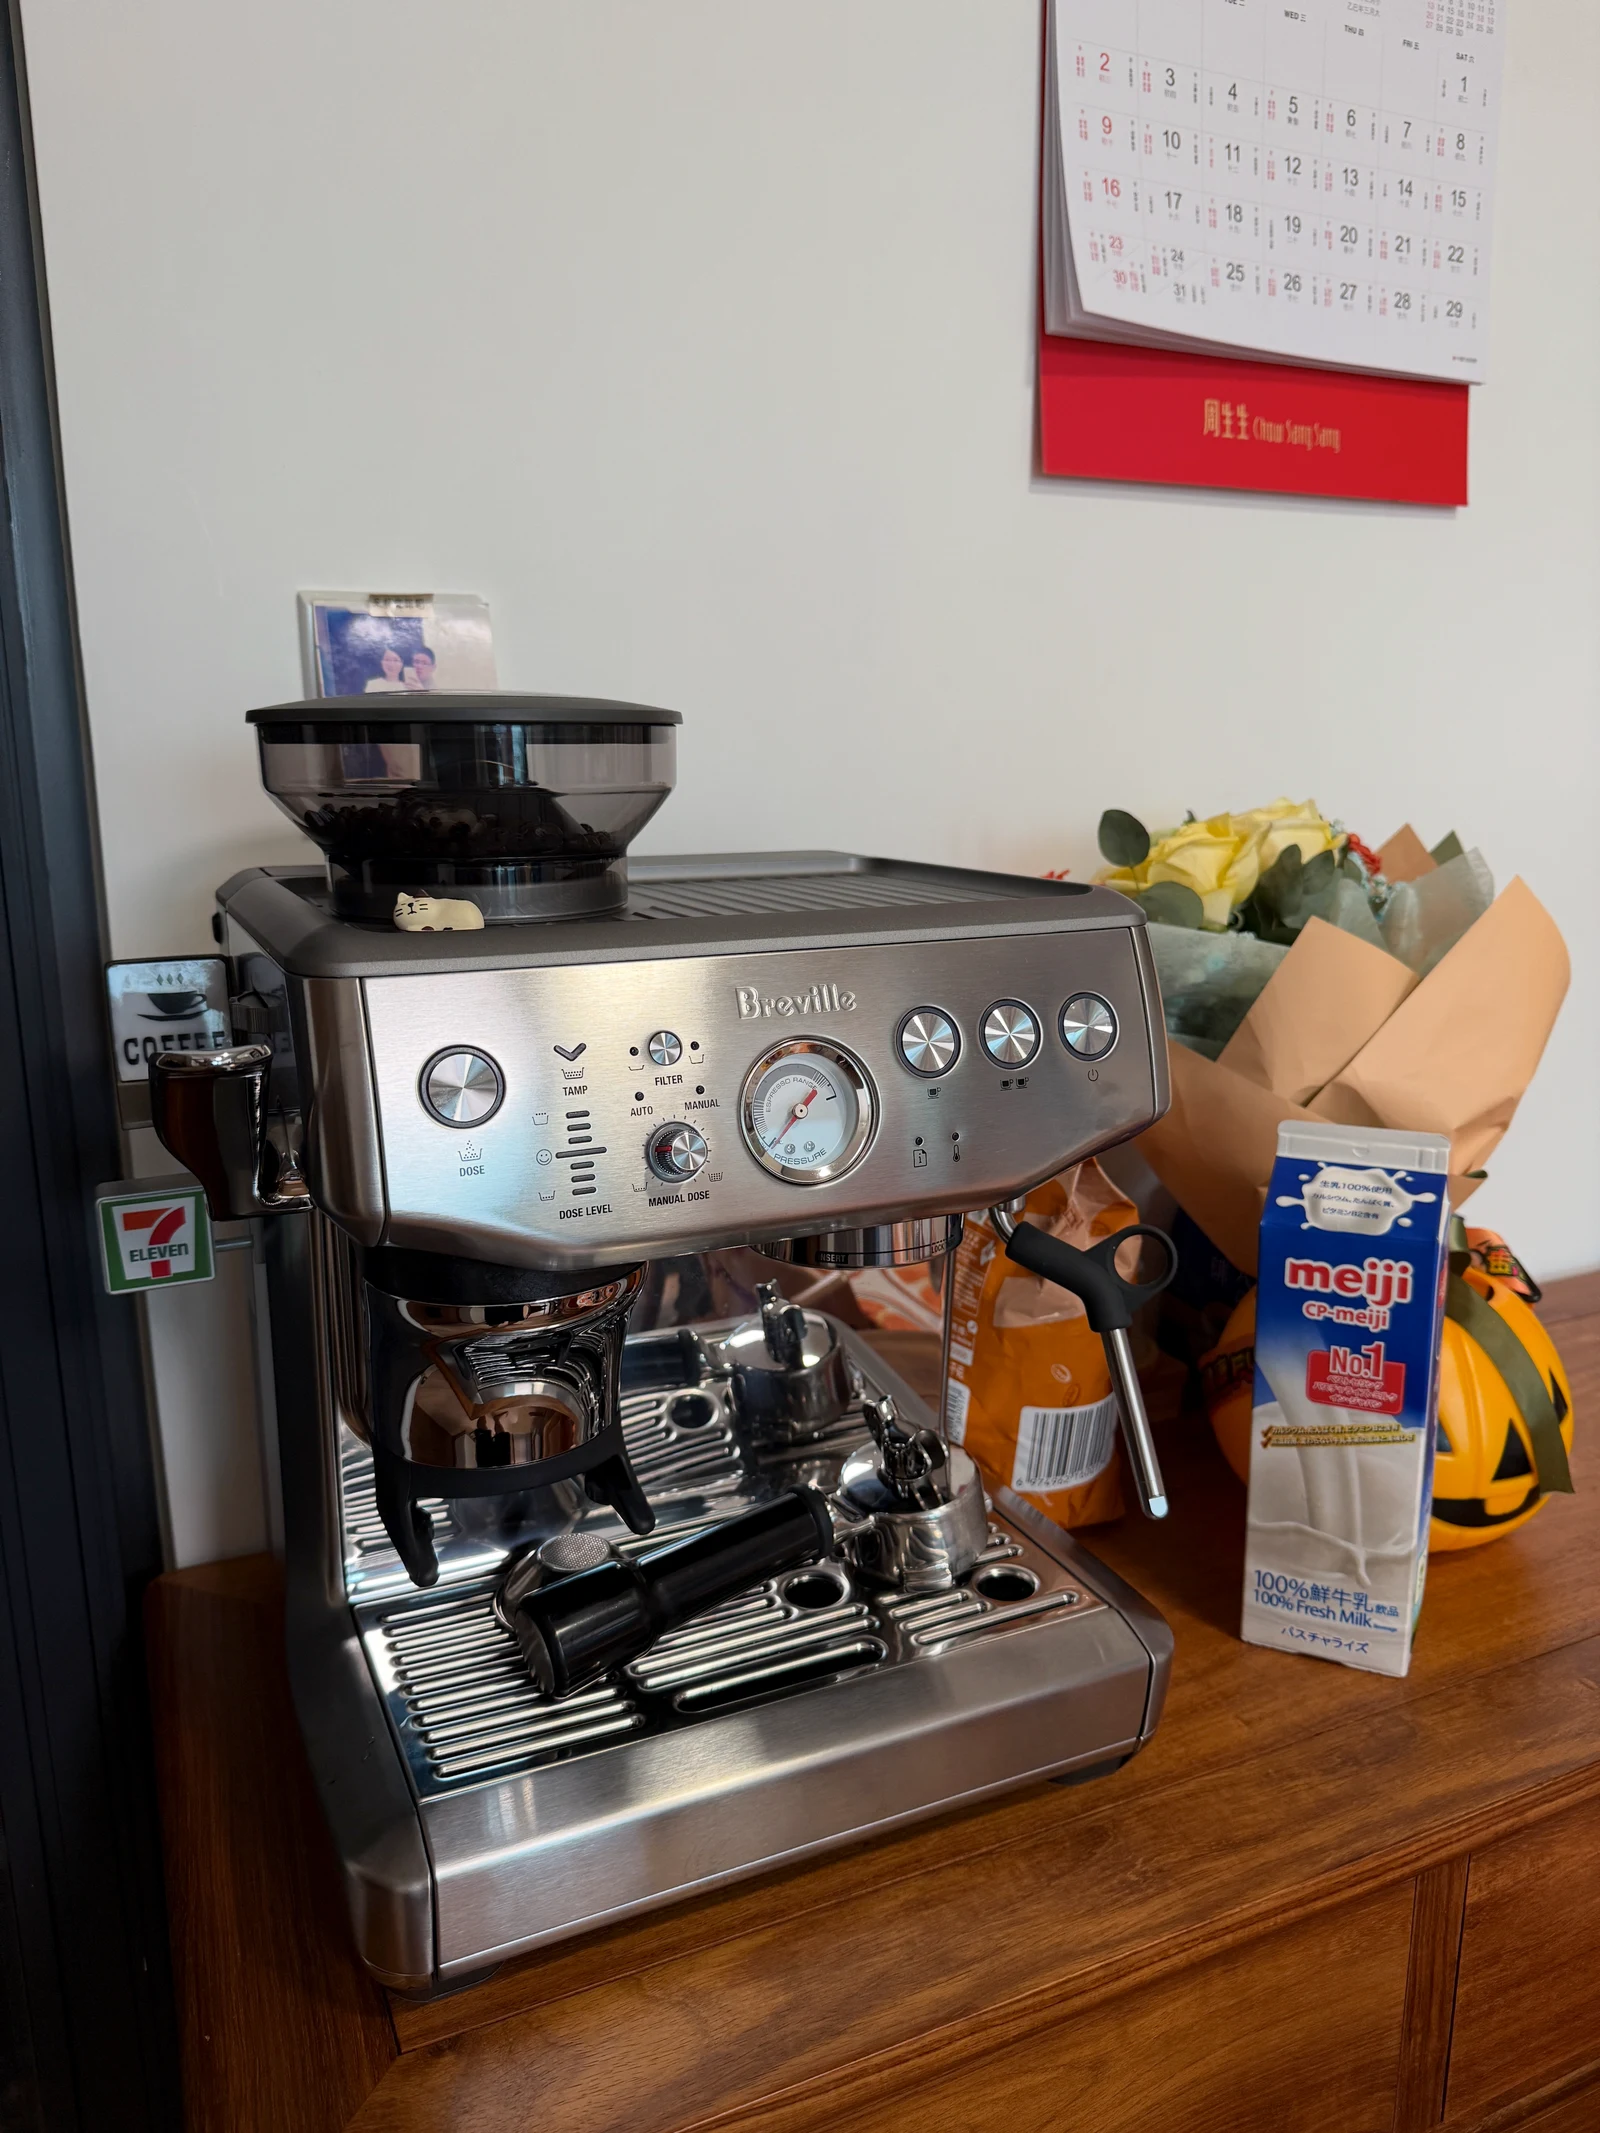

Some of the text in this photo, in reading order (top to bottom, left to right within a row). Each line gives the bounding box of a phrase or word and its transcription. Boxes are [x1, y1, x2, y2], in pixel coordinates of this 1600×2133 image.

[1284, 10, 1299, 20] WED
[1344, 25, 1358, 35] THU
[1402, 39, 1413, 48] FRI
[1099, 52, 1111, 72] 2
[1456, 52, 1468, 61] SAT
[1165, 67, 1176, 87] 3
[1460, 75, 1468, 93] 1
[1227, 82, 1238, 101] 4
[1288, 95, 1299, 115] 5
[1101, 115, 1113, 135] 9
[1346, 108, 1357, 127] 6
[1403, 120, 1412, 139] 7
[1162, 129, 1182, 151] 10
[1456, 132, 1466, 151] 8
[1225, 142, 1241, 163] 11
[1284, 155, 1302, 175] 12
[1102, 176, 1121, 198] 16
[1342, 167, 1359, 187] 13
[1397, 178, 1413, 198] 14
[1164, 190, 1182, 210] 17
[1451, 189, 1467, 208] 15
[1225, 203, 1243, 223] 18
[1284, 214, 1302, 234] 19
[1108, 234, 1124, 251] 23
[1339, 224, 1358, 245] 20
[1394, 234, 1411, 255] 21
[1170, 248, 1185, 263] 24
[1447, 244, 1465, 264] 22
[1112, 268, 1128, 285] 30
[1225, 261, 1245, 283] 25
[1172, 282, 1186, 298] 31
[1283, 272, 1302, 293] 26
[1339, 282, 1358, 302] 27
[1393, 291, 1412, 311] 28
[1445, 299, 1464, 319] 29
[1203, 398, 1341, 454] 周生生 Chow Sang Sang
[735, 983, 858, 1019] Breville
[562, 1084, 588, 1097] TAMP
[654, 1074, 684, 1087] FILTER
[765, 1076, 818, 1113] ESPRESSO RANGE
[629, 1105, 654, 1117] AUTO
[684, 1098, 721, 1112] MANUAL
[773, 1147, 827, 1165] PRESSURE
[458, 1164, 486, 1178] DOSE
[1319, 1180, 1393, 1195] 生乳100%使用
[648, 1190, 711, 1208] MANUAL DOSE
[558, 1203, 614, 1221] DOSE LEVEL
[122, 1205, 187, 1279] 7
[931, 1244, 946, 1255] LOCK
[1285, 1257, 1412, 1307] meiji
[1303, 1301, 1389, 1332] CP-meiji
[1329, 1341, 1385, 1380] No.1
[1253, 1588, 1295, 1612] 100%
[1296, 1599, 1337, 1621] Fresh
[1339, 1608, 1373, 1629] Milk
[1280, 1626, 1370, 1654] パスチャライズ
